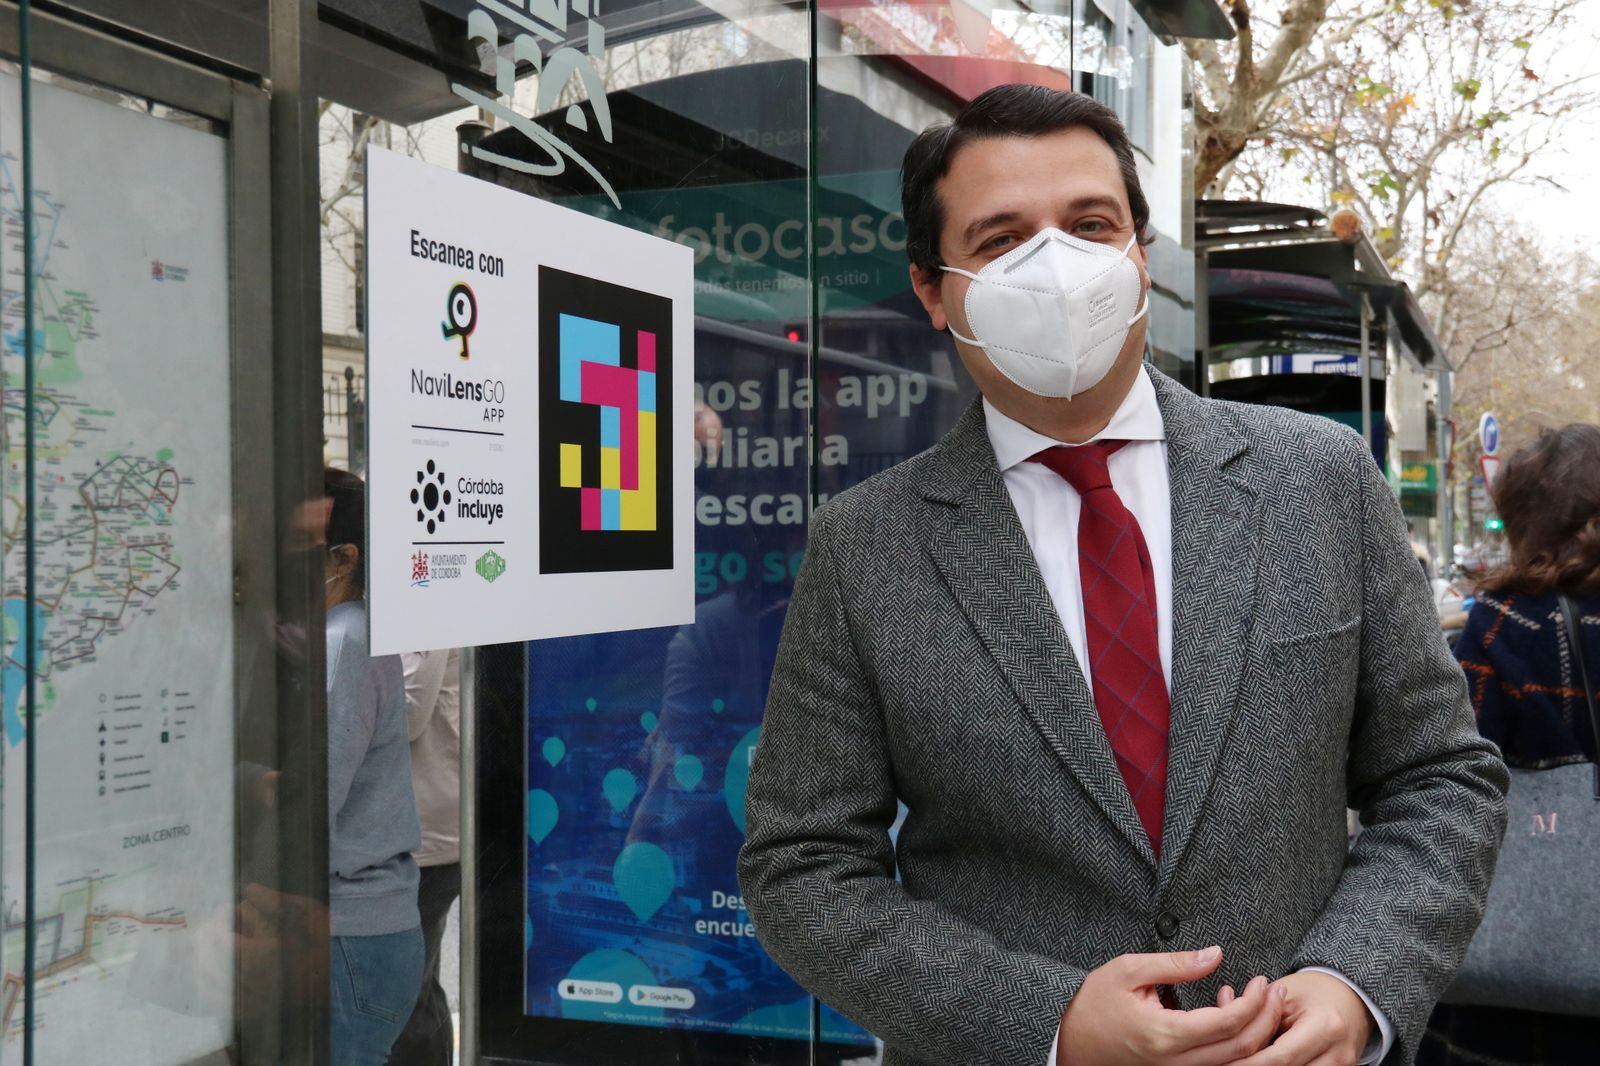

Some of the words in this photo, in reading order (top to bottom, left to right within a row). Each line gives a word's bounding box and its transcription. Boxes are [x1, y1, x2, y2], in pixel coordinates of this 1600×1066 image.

[713, 127, 831, 152] JCDecax
[410, 229, 474, 269] Escanea
[479, 252, 504, 277] con
[736, 275, 806, 292] tenemos
[836, 270, 868, 286] sitio
[411, 368, 505, 404] NaviLensGO
[778, 369, 813, 409] la
[836, 372, 928, 418] app
[483, 407, 505, 423] APP
[457, 477, 504, 495] Córdoba
[457, 499, 504, 525] incluye
[432, 554, 467, 566] AYUNTAMIENTO
[431, 568, 439, 579] DE
[695, 550, 746, 594] go
[1531, 812, 1557, 835] M
[122, 832, 151, 849] ZONA
[153, 824, 191, 843] CENTRO
[711, 890, 746, 910] Des
[695, 919, 756, 938] encue
[578, 986, 593, 997] App
[595, 987, 614, 997] Store
[650, 991, 672, 1002] Google
